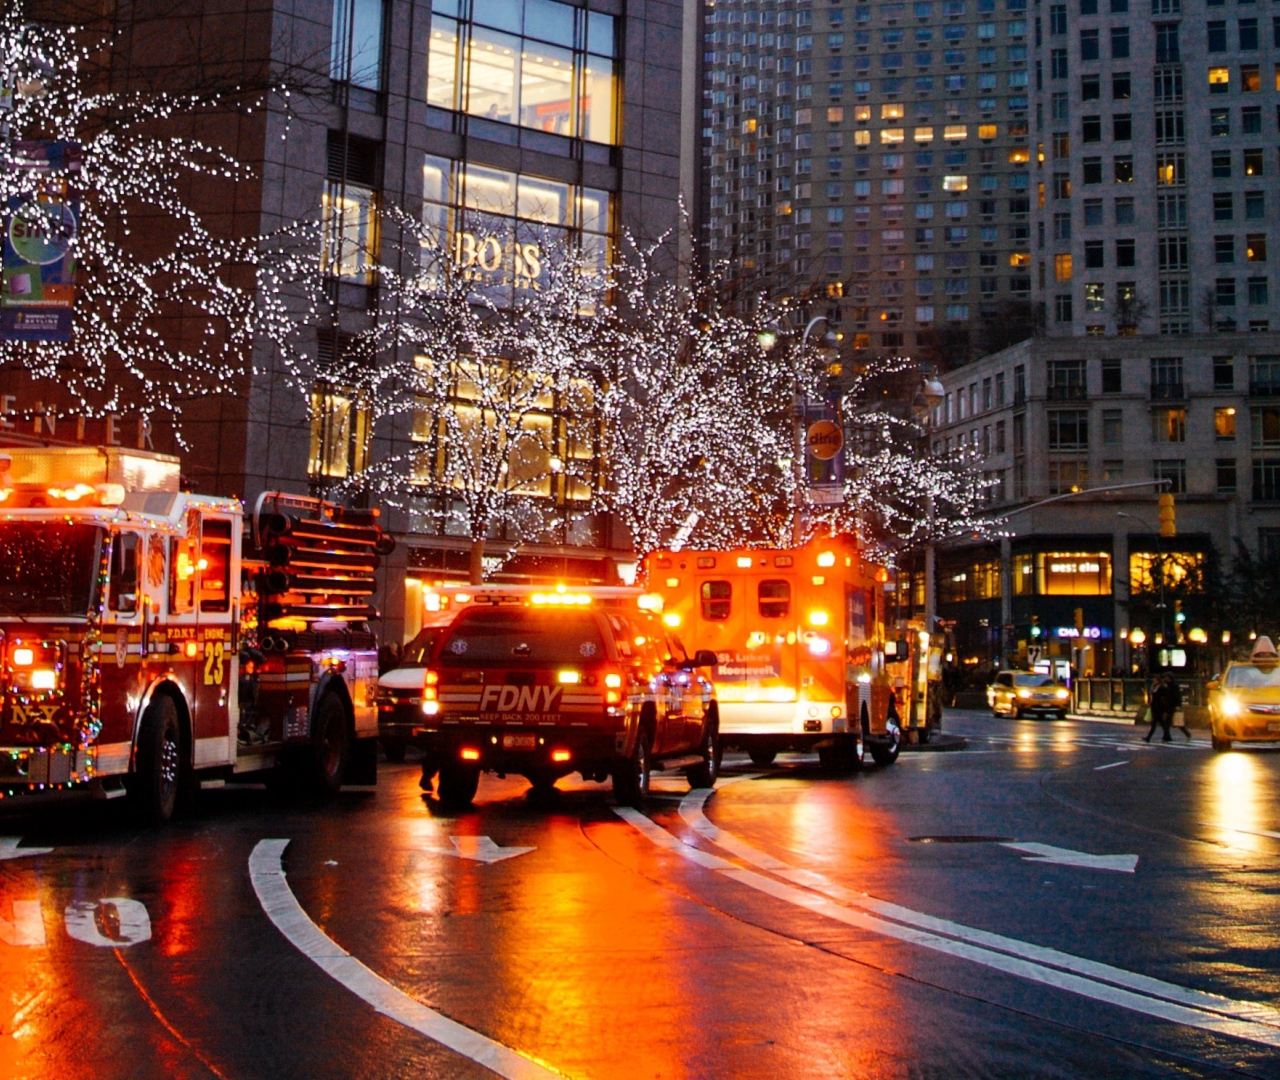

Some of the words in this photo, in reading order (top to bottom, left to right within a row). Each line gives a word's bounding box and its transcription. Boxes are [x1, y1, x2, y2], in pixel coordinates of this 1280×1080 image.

[1058, 627, 1091, 638] CHAE
[204, 641, 224, 685] 23
[718, 665, 775, 676] Roosevelt
[479, 685, 563, 712] FDNY
[502, 713, 523, 721] BACK
[525, 713, 540, 721] 200
[542, 714, 561, 722] FEET
